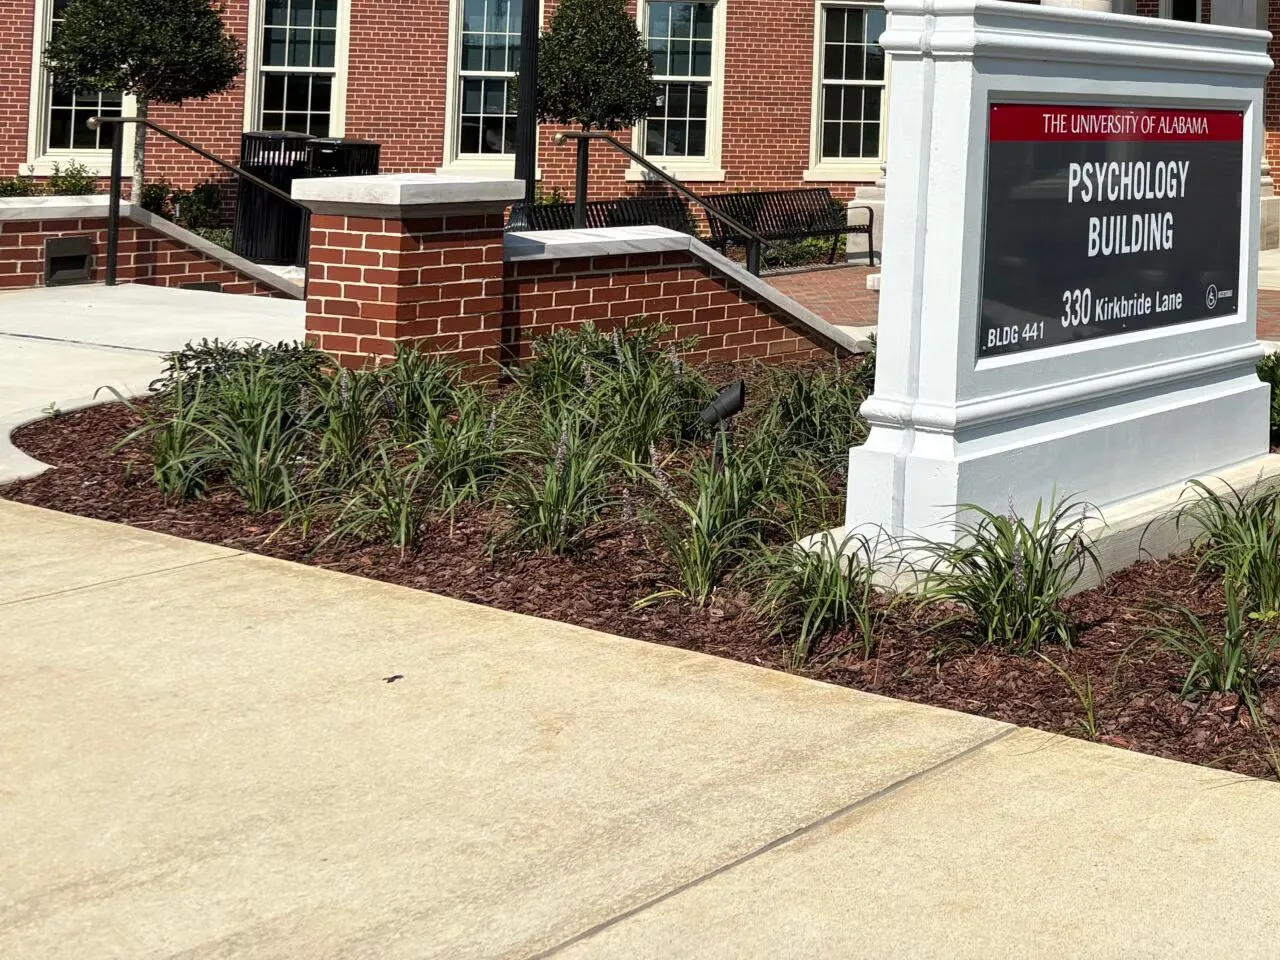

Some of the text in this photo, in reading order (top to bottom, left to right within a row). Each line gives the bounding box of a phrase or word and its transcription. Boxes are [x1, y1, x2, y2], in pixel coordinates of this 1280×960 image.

[1042, 114, 1209, 134] THE UNIVERSITY OF ALABAMA
[1067, 160, 1190, 203] PSYCHOLOGY
[1087, 212, 1173, 257] BUILDING
[1061, 287, 1183, 328] 330 Kirkbride Lane
[987, 321, 1044, 348] BLDG 441
